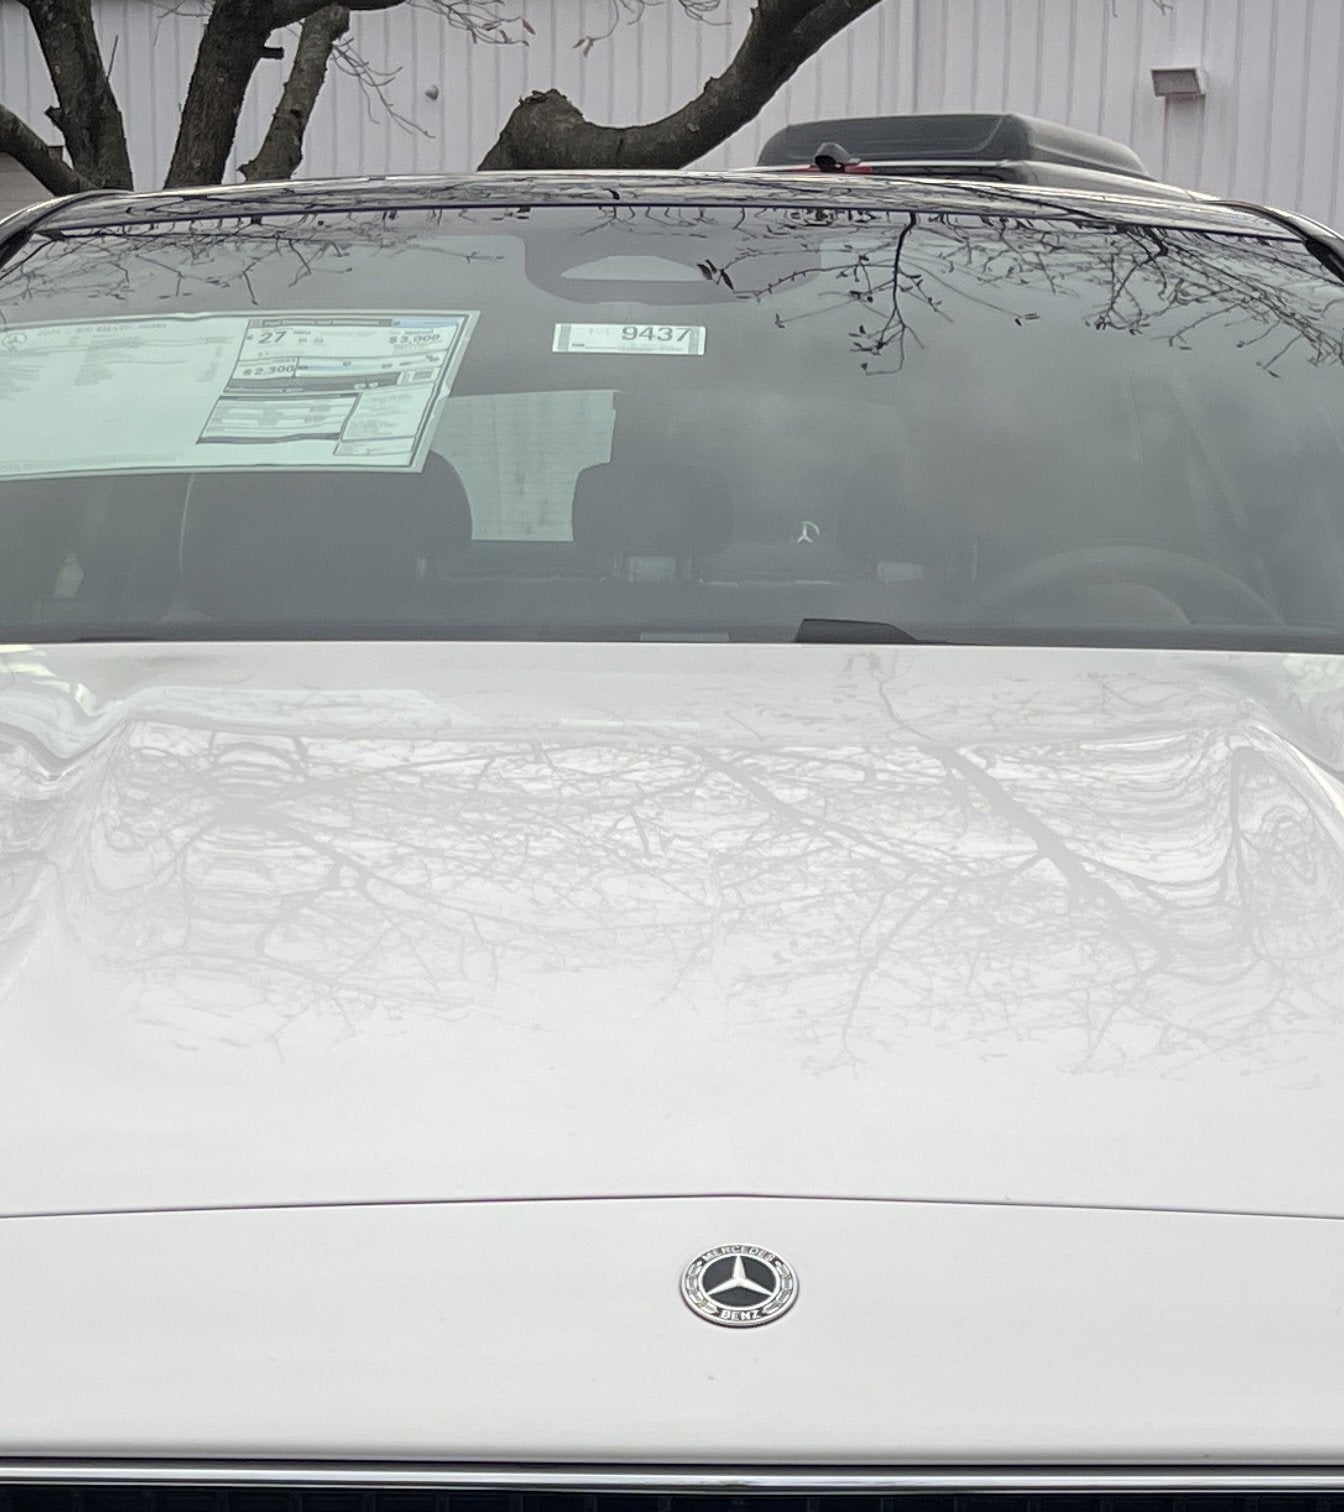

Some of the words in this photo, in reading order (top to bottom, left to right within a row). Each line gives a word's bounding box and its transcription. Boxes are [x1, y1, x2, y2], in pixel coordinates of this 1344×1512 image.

[258, 331, 287, 345] 27
[622, 326, 691, 342] 9437
[702, 1245, 774, 1262] MERCEDES
[720, 1309, 761, 1321] BENZ
